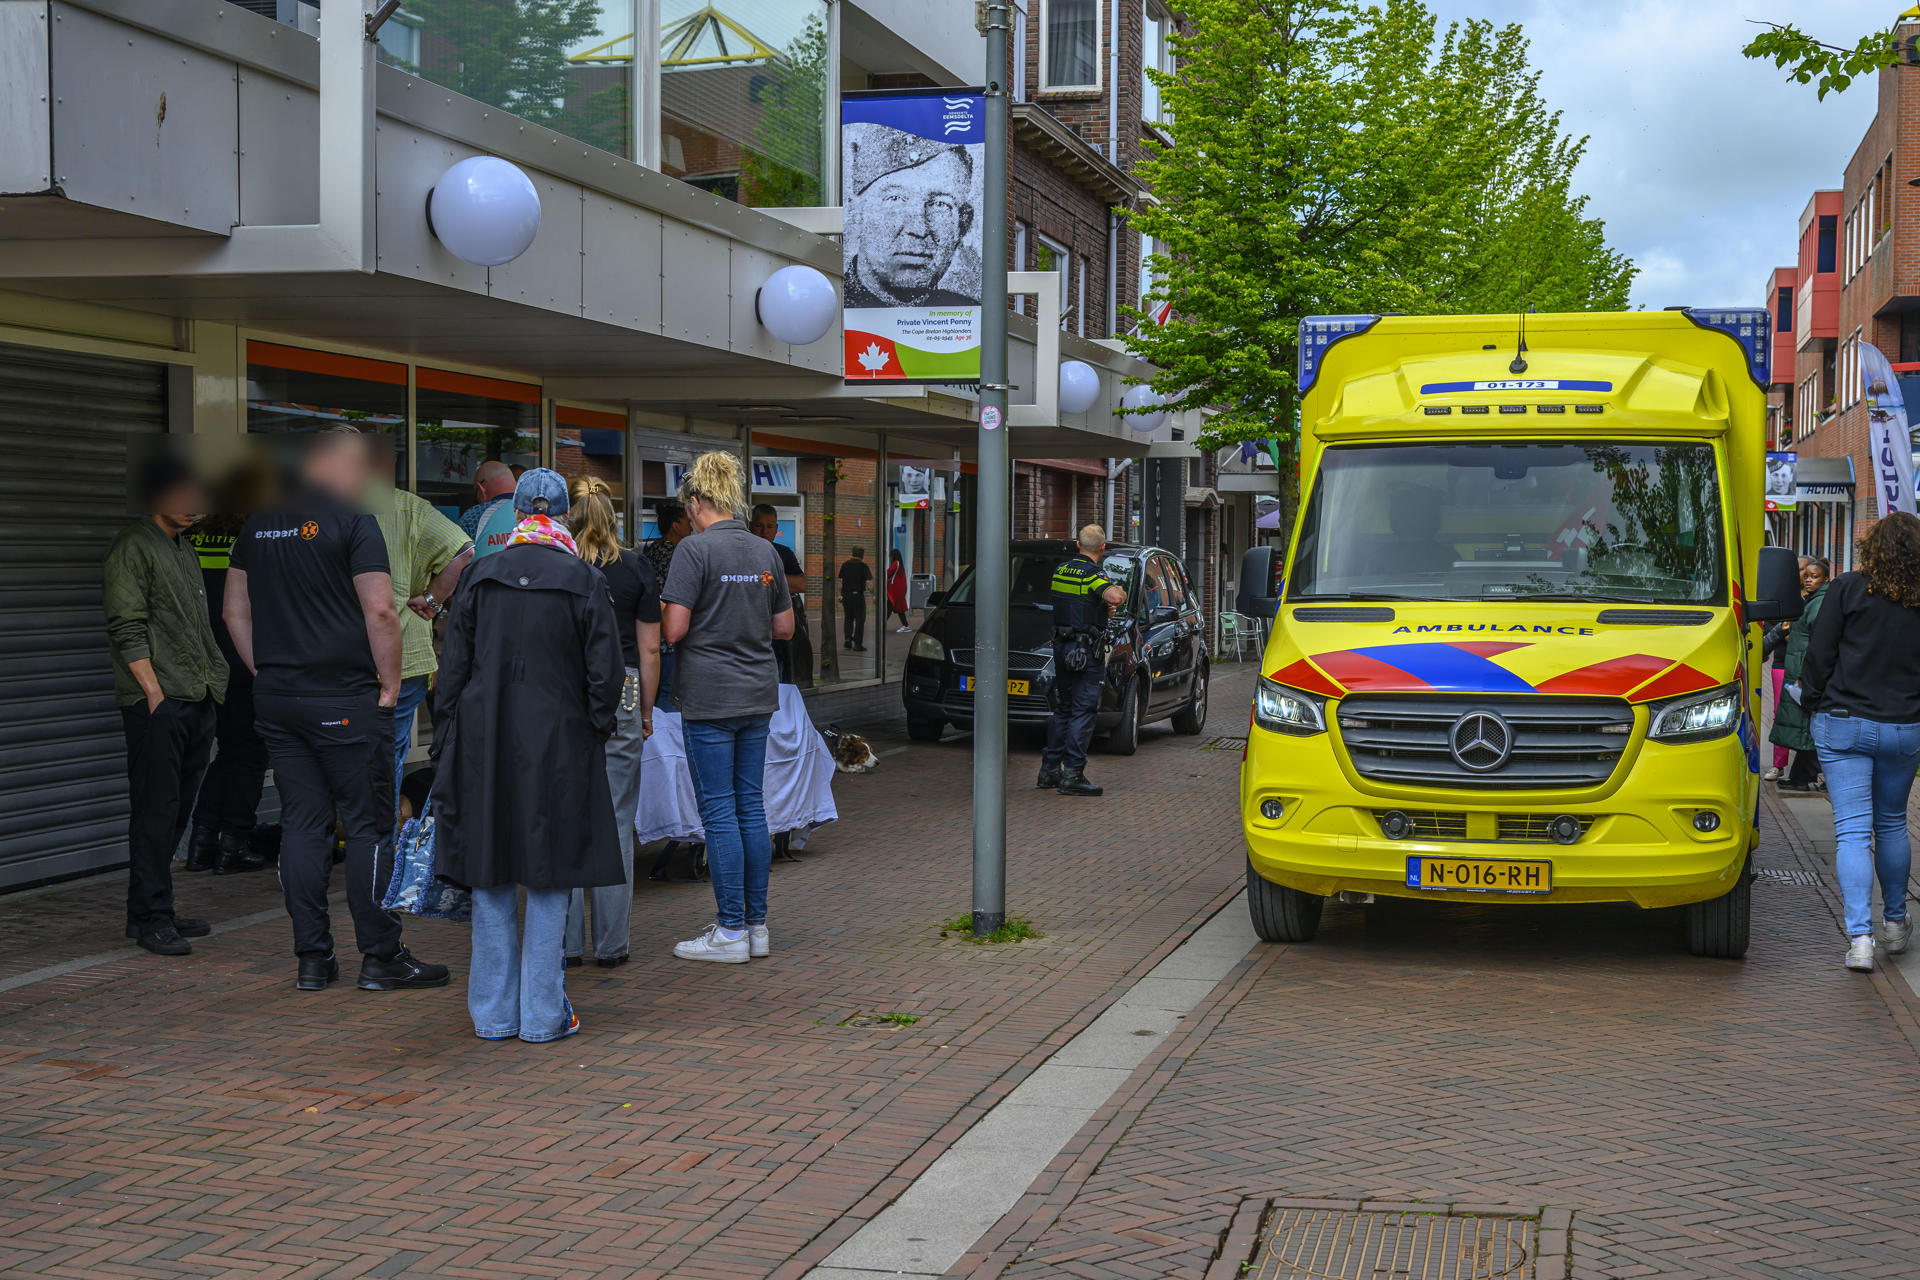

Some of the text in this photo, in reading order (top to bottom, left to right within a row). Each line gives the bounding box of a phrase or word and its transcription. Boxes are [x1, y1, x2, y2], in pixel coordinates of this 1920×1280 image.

[965, 309, 973, 318] of
[950, 318, 972, 327] Penny
[1487, 381, 1546, 389] 01-173
[1806, 485, 1846, 495] ACTION
[255, 527, 299, 540] expert
[720, 573, 759, 583] expert
[1392, 624, 1595, 636] AMBULANCE
[1410, 863, 1540, 886] NL N-016-RH
